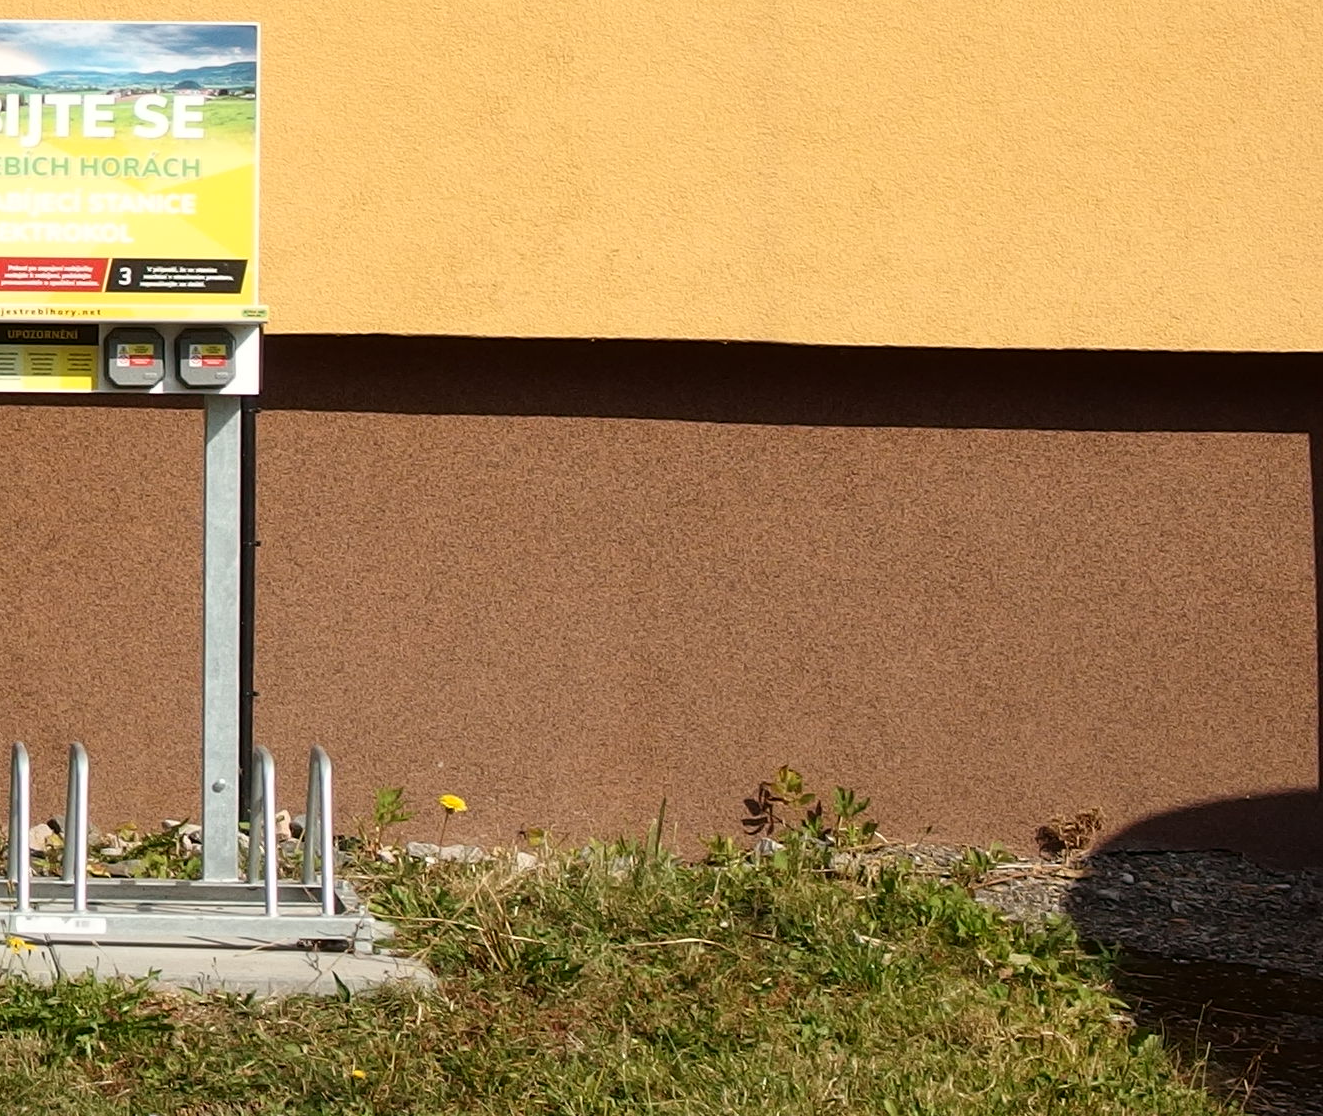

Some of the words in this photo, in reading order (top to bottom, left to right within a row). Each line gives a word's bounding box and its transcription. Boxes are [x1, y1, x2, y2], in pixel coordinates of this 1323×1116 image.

[133, 94, 205, 139] SE
[80, 152, 201, 178] HORÁCH
[89, 193, 197, 214] STANICE
[118, 266, 132, 285] 3
